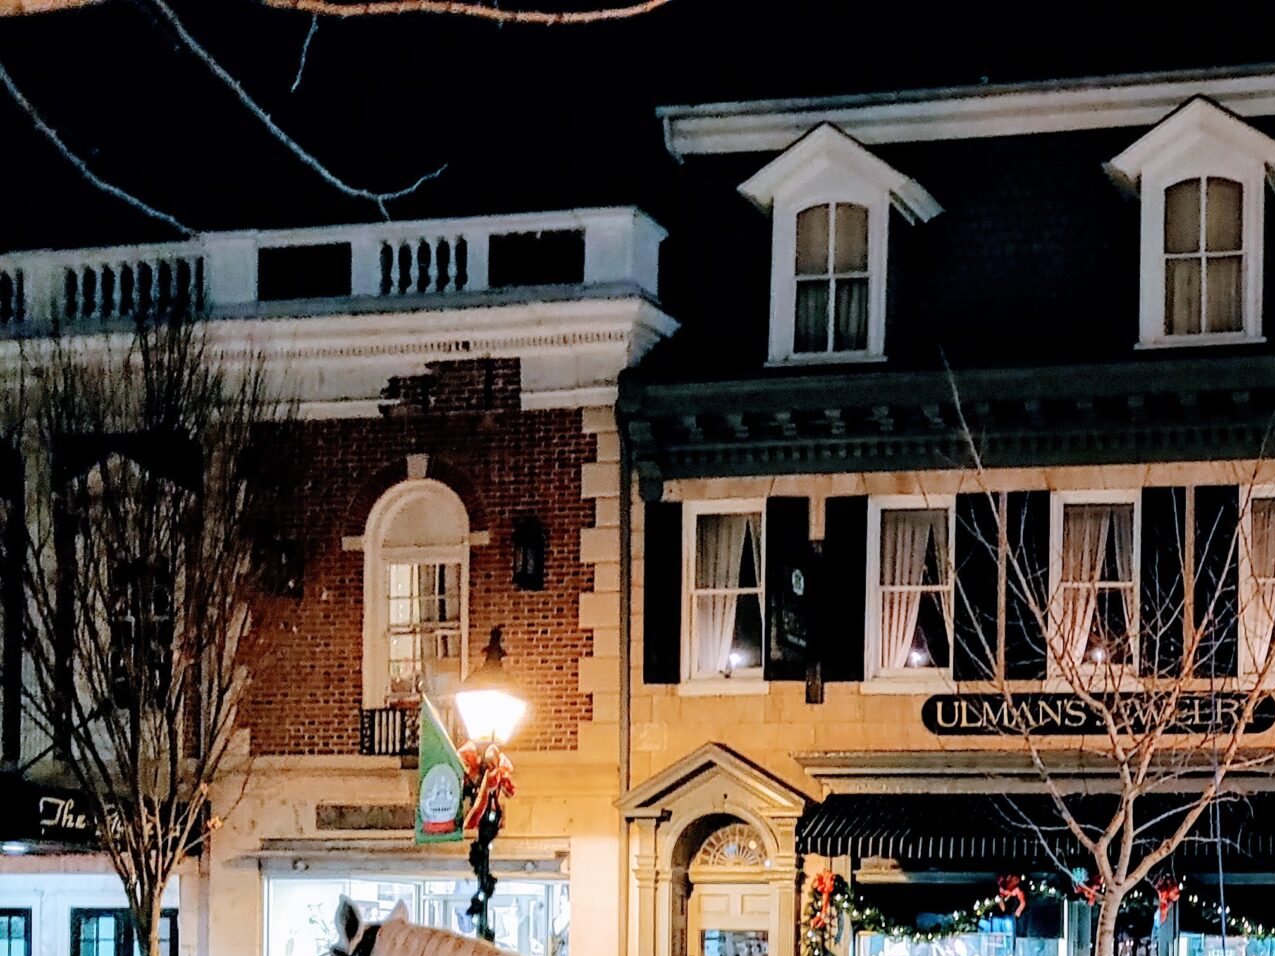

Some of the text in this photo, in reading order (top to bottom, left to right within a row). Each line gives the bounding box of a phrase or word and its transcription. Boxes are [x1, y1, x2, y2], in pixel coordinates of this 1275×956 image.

[936, 698, 1258, 727] ULMAN'S EWELR
[40, 797, 86, 834] The
